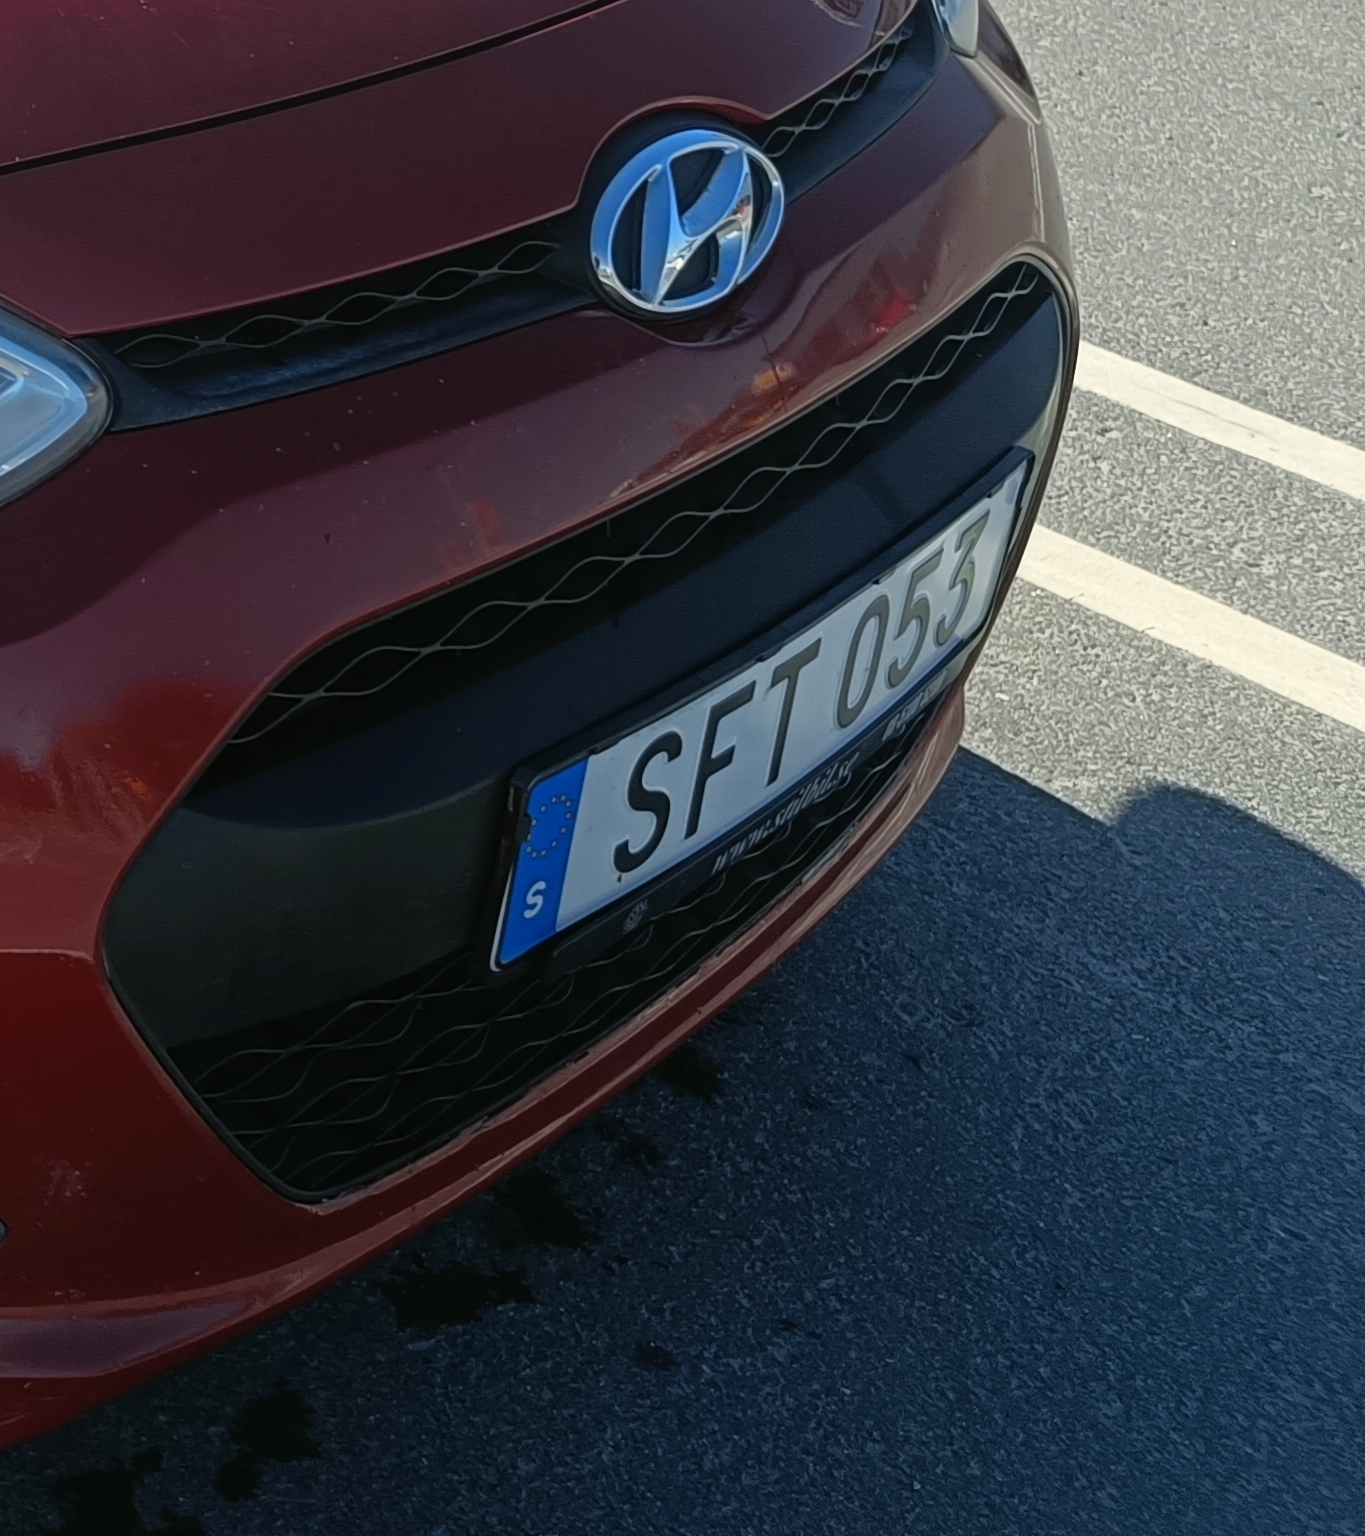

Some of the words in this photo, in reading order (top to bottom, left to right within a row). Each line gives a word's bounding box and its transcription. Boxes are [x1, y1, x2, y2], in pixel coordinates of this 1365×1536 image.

[613, 636, 823, 874] SFT
[836, 509, 991, 730] 053
[523, 880, 546, 919] S
